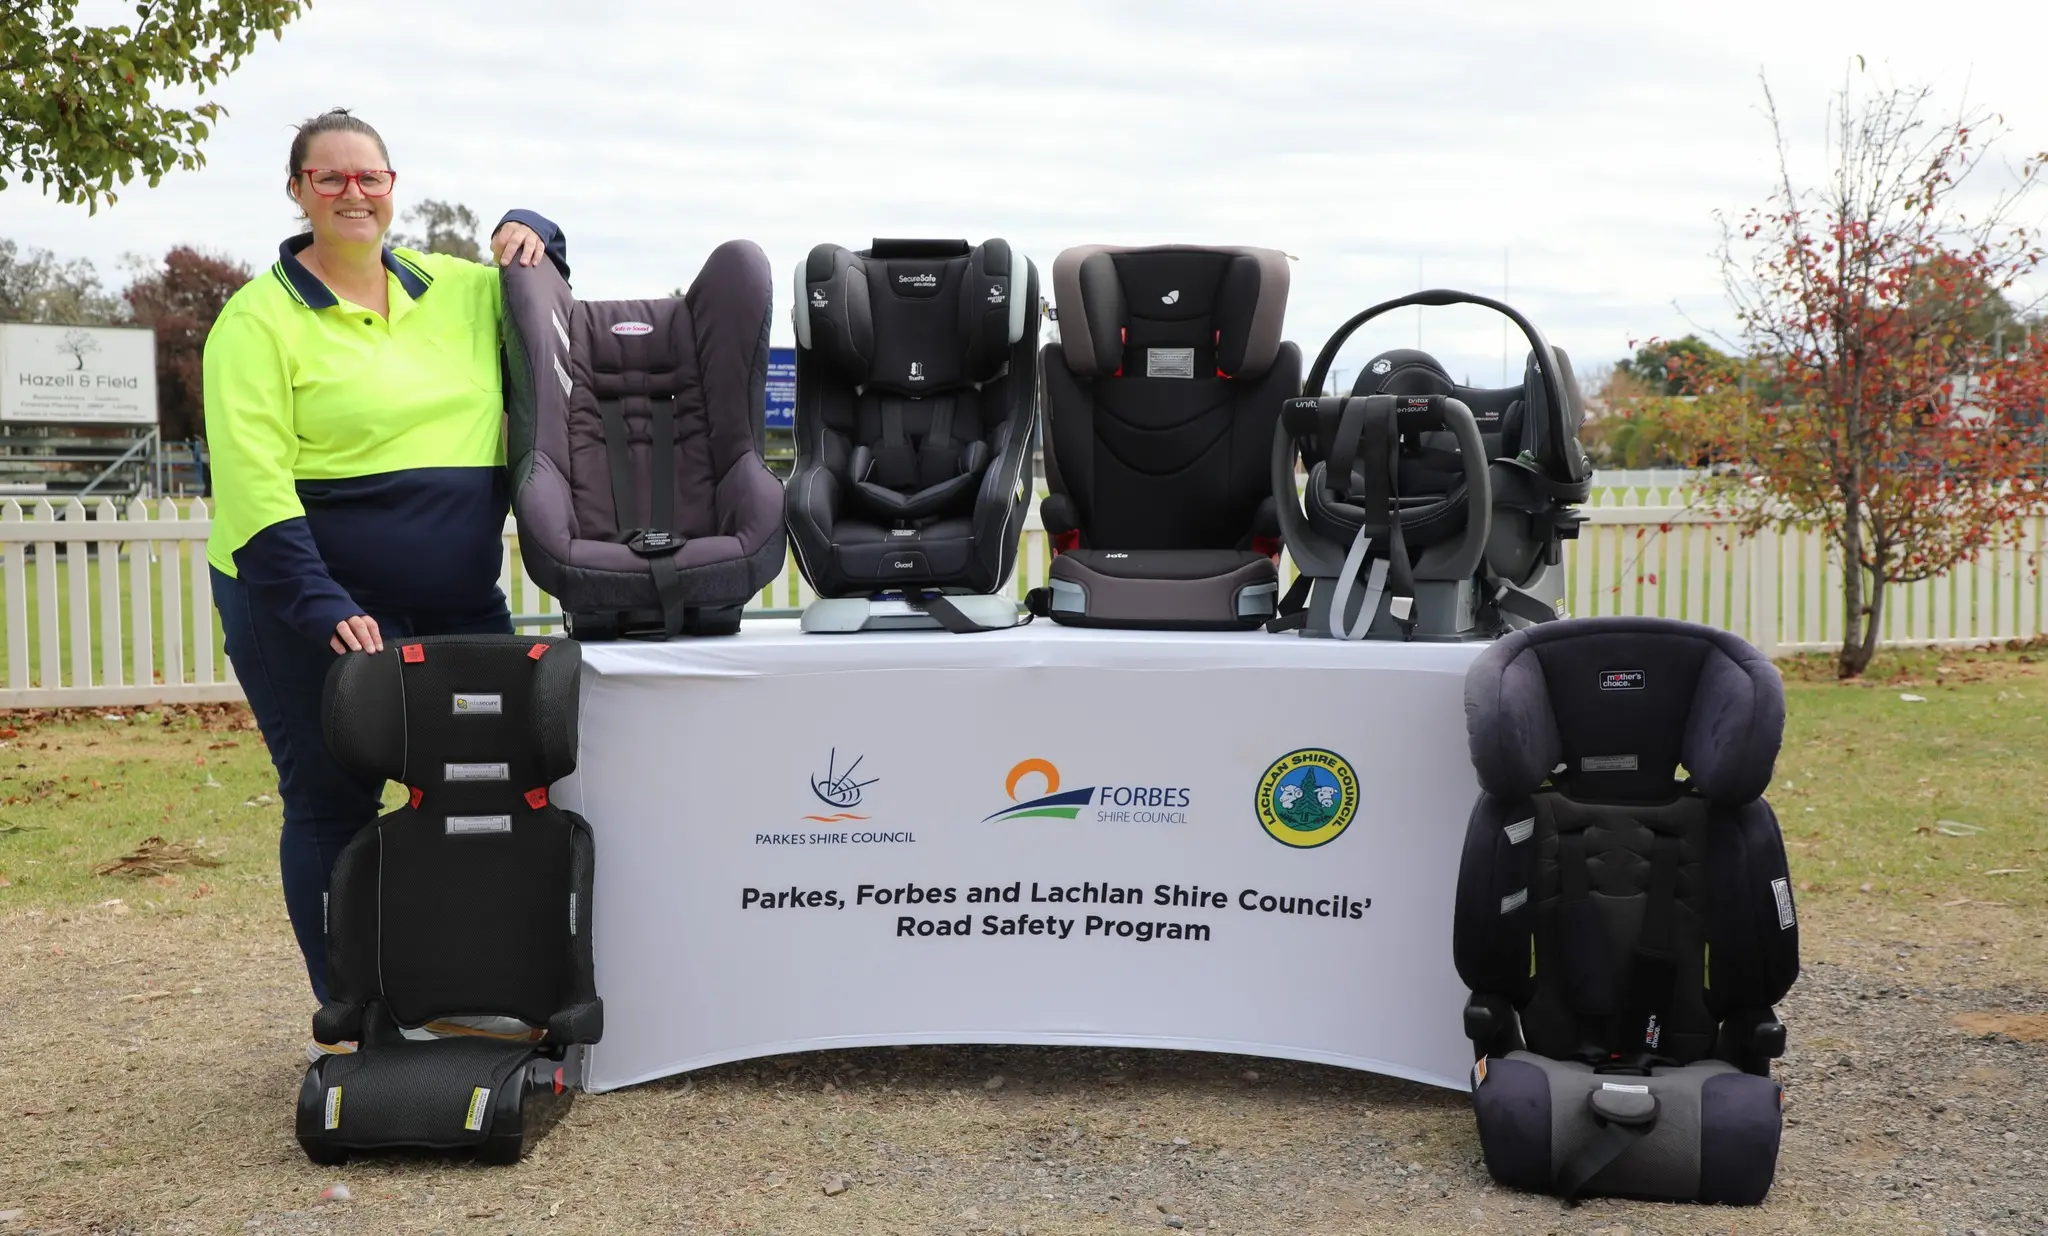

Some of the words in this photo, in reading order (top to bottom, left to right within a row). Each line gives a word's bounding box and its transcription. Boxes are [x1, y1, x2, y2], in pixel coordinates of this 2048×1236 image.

[899, 273, 937, 283] SecureSafe
[19, 373, 74, 387] Hazell
[79, 375, 91, 388] &
[96, 376, 138, 389] Field
[894, 560, 914, 569] Guard
[1100, 786, 1191, 808] FORBES
[1261, 763, 1289, 825] LACHLAN
[1291, 753, 1338, 768] SHIRE
[1331, 766, 1355, 827] COUNCIL
[1097, 810, 1130, 822] SHIRE
[1133, 811, 1188, 824] COUNCIL
[755, 833, 806, 845] PARKES
[809, 832, 849, 845] SHIRE
[851, 832, 916, 844] COUNCIL
[742, 886, 846, 910] Parkes,
[856, 883, 957, 905] Forbes
[966, 881, 1021, 903] and
[1031, 882, 1143, 904] Lachlan
[1153, 884, 1228, 908] Shire
[896, 914, 972, 937] Road
[981, 914, 1075, 939] Safety
[1085, 915, 1211, 942] Program
